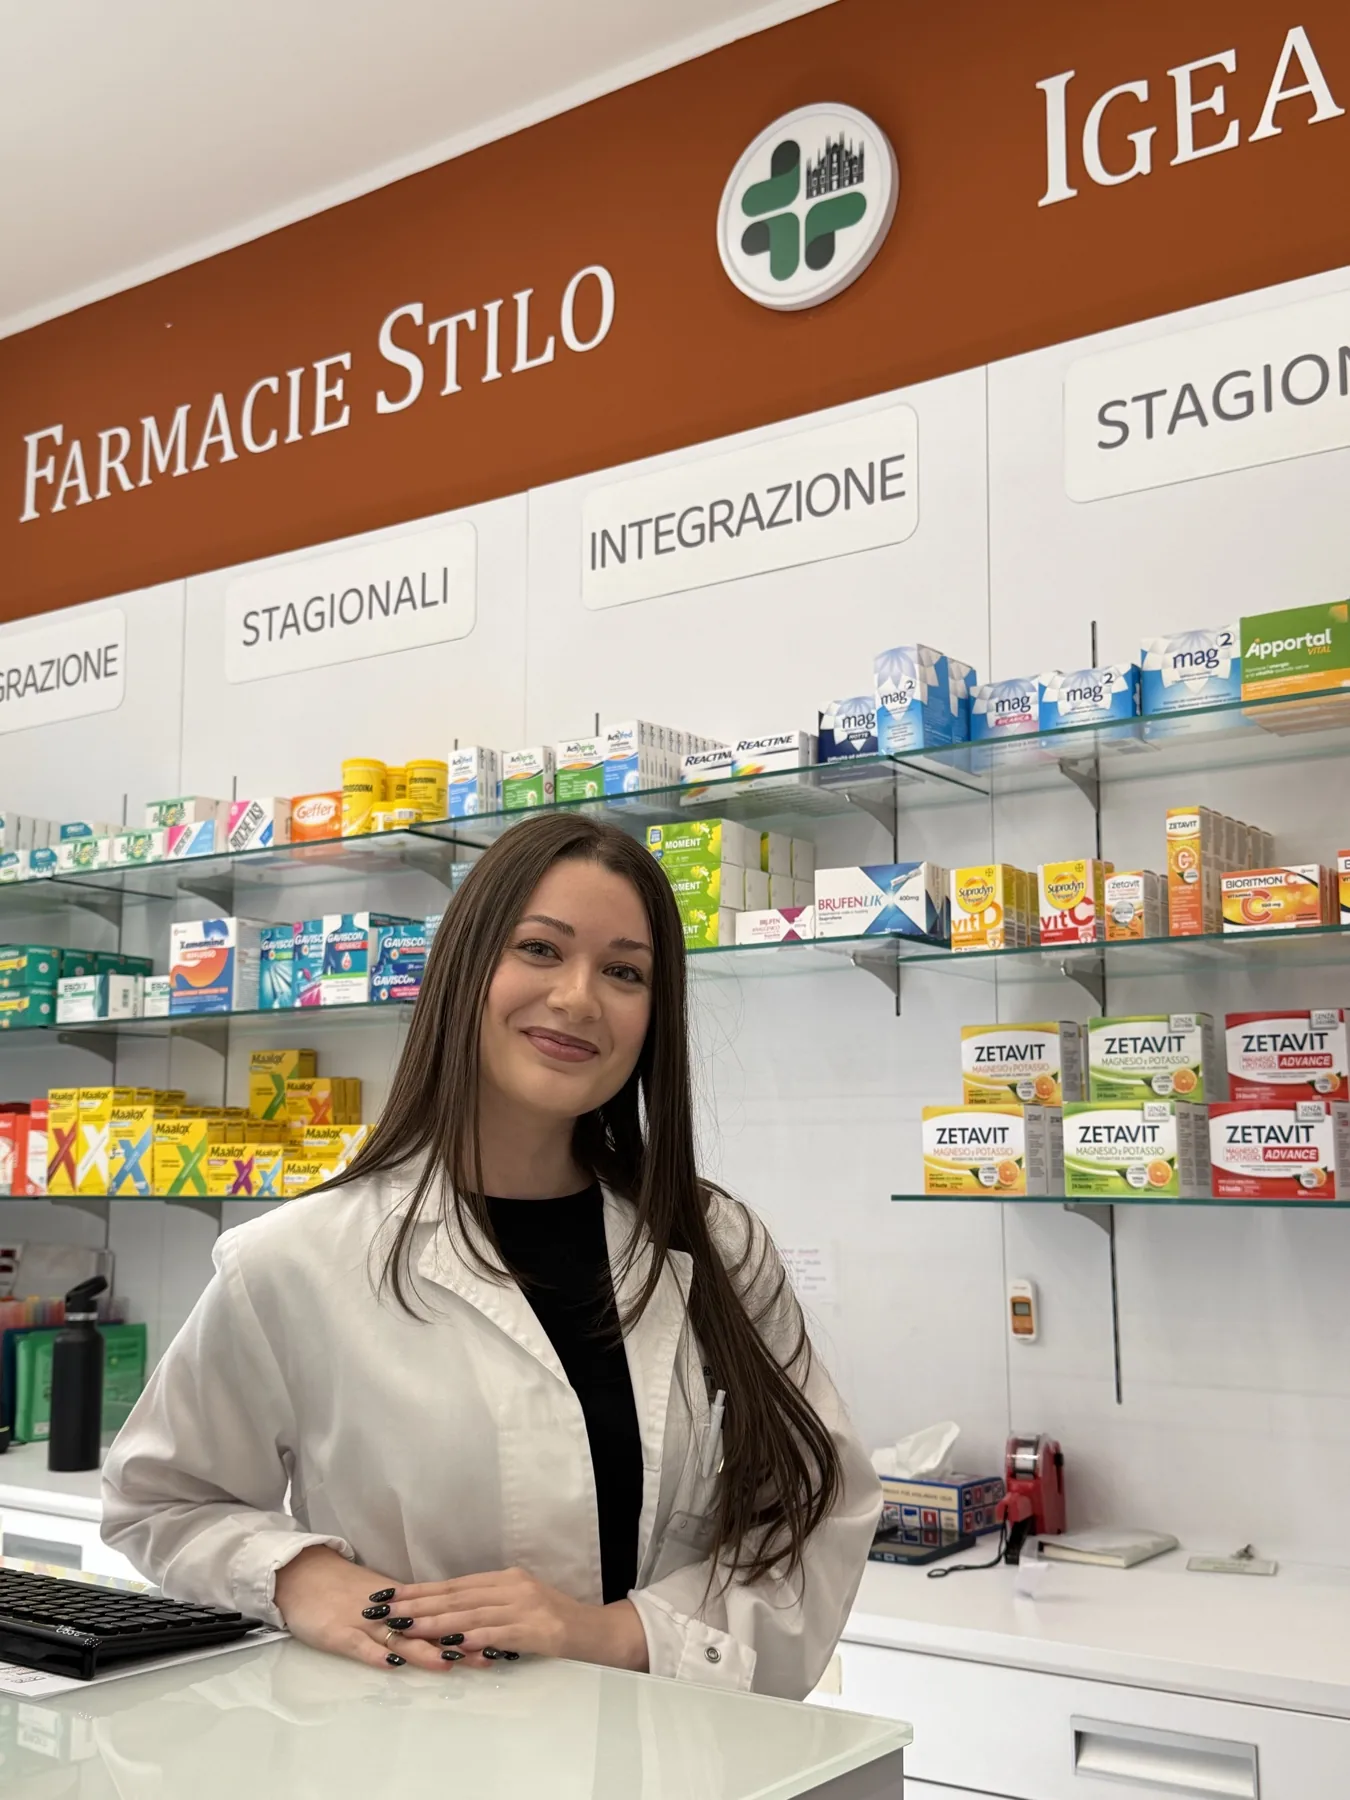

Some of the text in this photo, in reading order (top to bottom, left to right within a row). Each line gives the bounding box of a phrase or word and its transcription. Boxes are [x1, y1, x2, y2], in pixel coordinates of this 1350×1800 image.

[1036, 25, 1346, 208] IGEA
[18, 264, 616, 523] FARMACIE STILO
[1097, 345, 1350, 450] STAGIO
[591, 453, 906, 571] INTEGRAZIONE
[242, 566, 449, 648] STAGIONALI
[1244, 628, 1332, 660] Apportal
[1307, 645, 1332, 656] VITAL
[1172, 648, 1220, 669] mag
[880, 690, 908, 705] mag
[1066, 685, 1104, 703] mag
[995, 695, 1031, 714] mag
[841, 712, 876, 730] mag
[736, 734, 794, 751] REACTINE
[684, 750, 732, 767] REACTIN
[296, 803, 334, 819] Geffer
[665, 838, 701, 850] MOMENT
[671, 880, 701, 892] OMENT
[1225, 875, 1283, 890] BIORITMON
[261, 938, 294, 951] GAVISCO
[384, 935, 425, 948] GAVISCO
[1104, 1035, 1186, 1055] ZETAVIT
[1241, 1033, 1329, 1053] ZETAVIT
[974, 1043, 1046, 1063] ZETAVIT
[1101, 1056, 1143, 1066] MAGNESIO
[1149, 1055, 1190, 1065] POTASSIO
[1280, 1055, 1331, 1067] ADVANCE
[972, 1064, 1009, 1074] MAGNESIO
[1013, 1062, 1050, 1073] POTASSIO
[111, 1108, 147, 1121] Maalox
[156, 1121, 192, 1136] Maalox
[305, 1127, 343, 1140] Maalox
[936, 1127, 1010, 1145] ZETAVIT
[1078, 1125, 1160, 1144] ZETAVIT
[1225, 1125, 1315, 1144] ZETAVIT
[210, 1145, 247, 1159] Maalox
[933, 1147, 972, 1157] MAGNESIO
[976, 1147, 1014, 1156] POTASSIO
[1075, 1147, 1118, 1156] MAGNESIO
[1122, 1147, 1165, 1156] POTASSIO
[1264, 1149, 1318, 1160] ADVANCE
[286, 1162, 323, 1175] Maalox
